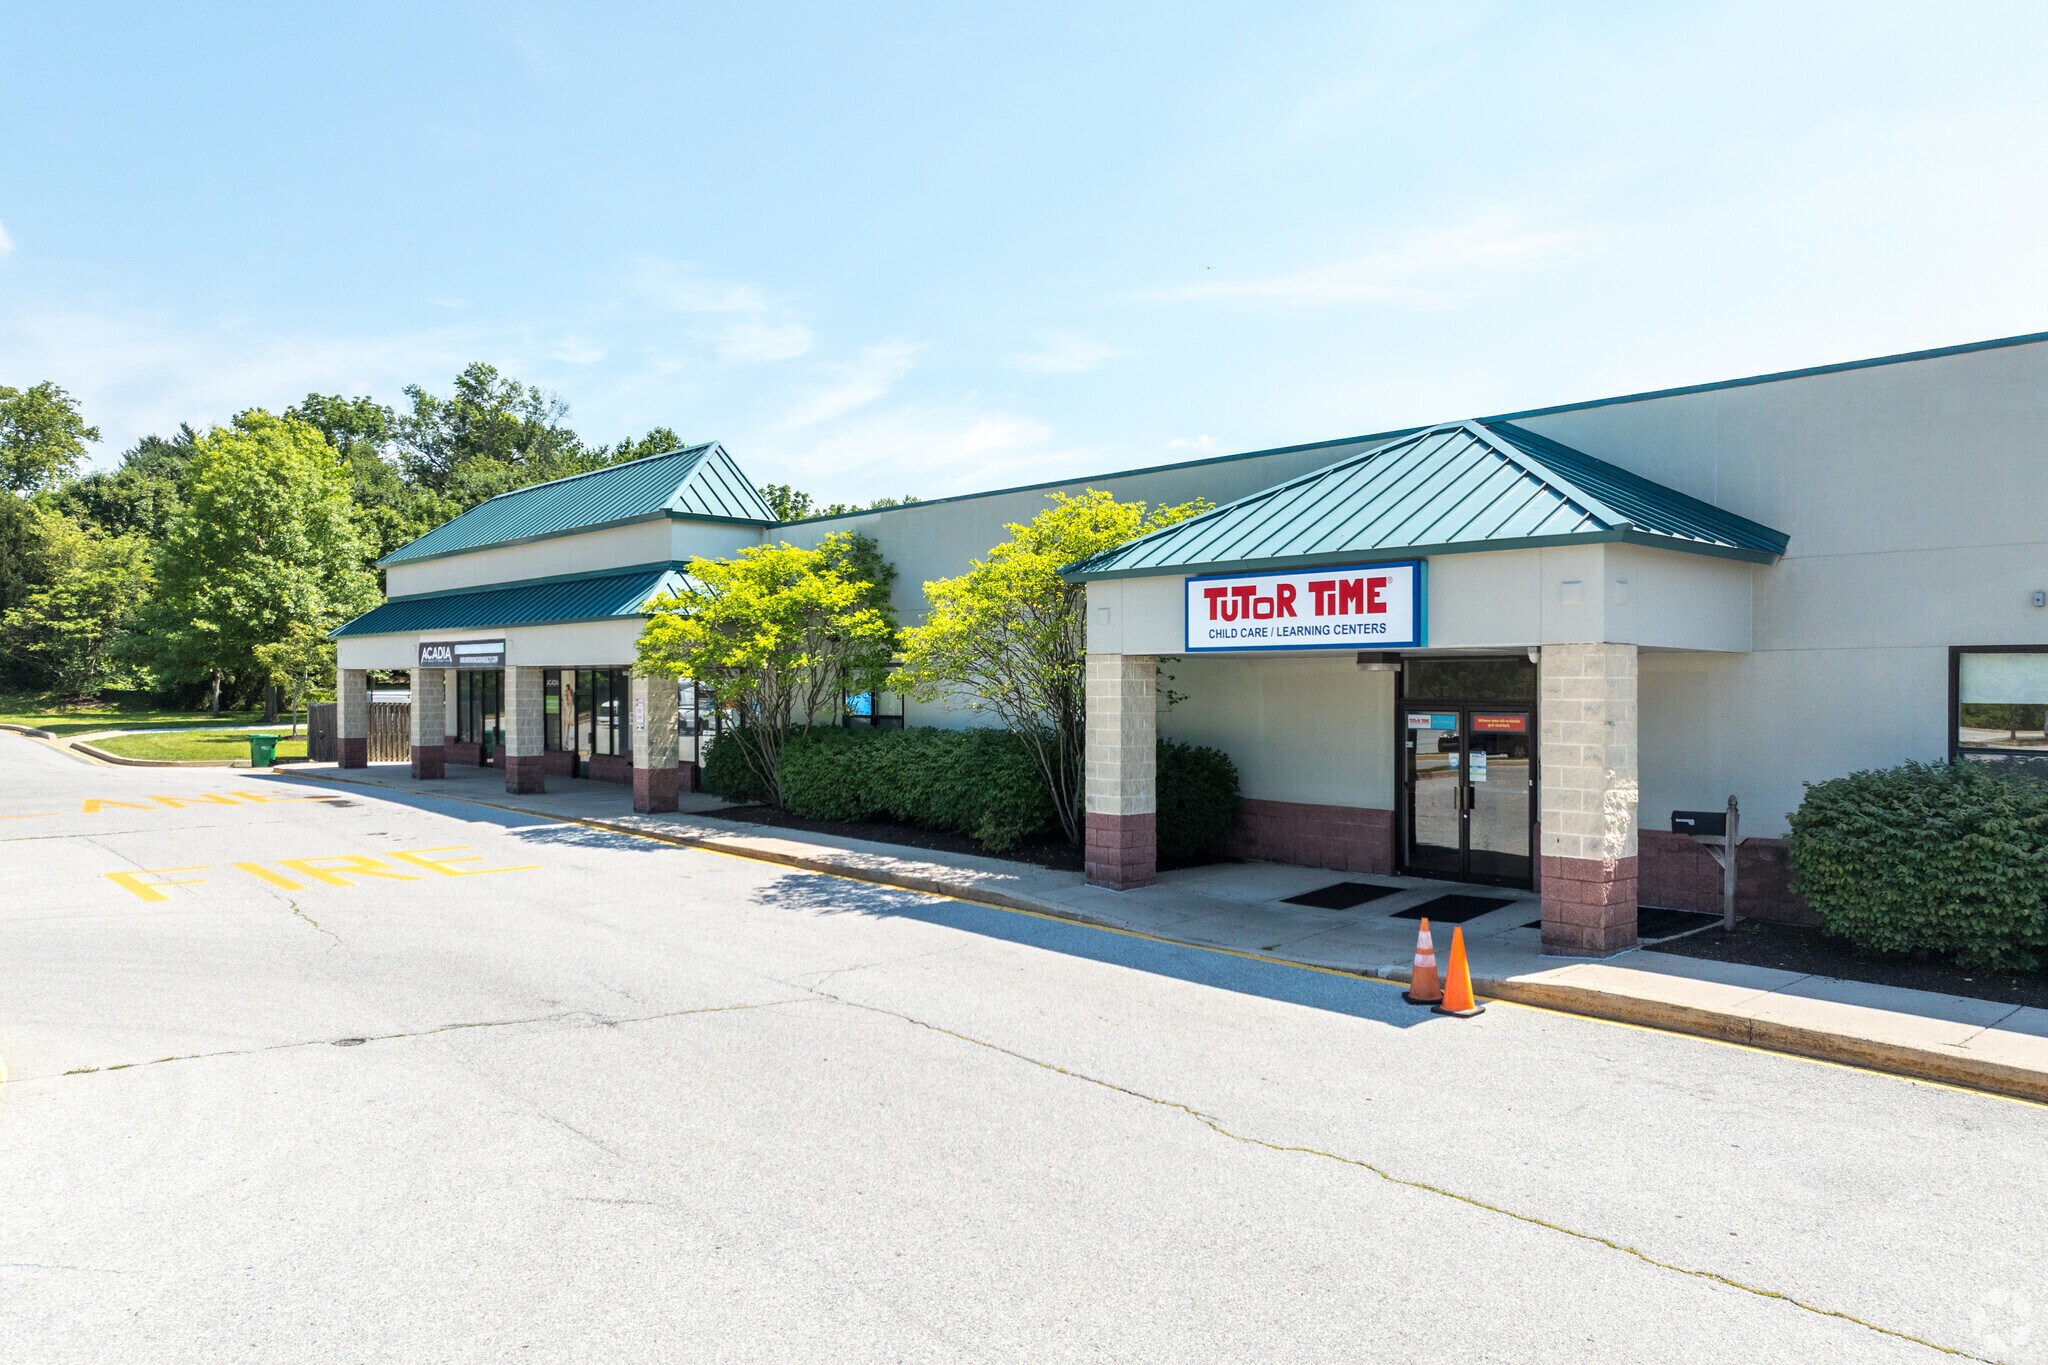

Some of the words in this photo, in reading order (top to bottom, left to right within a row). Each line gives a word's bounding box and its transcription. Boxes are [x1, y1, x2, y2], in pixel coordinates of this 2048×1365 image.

[1203, 583, 1297, 621] TUTOR
[1208, 628, 1238, 640] CHILD
[1240, 627, 1268, 639] CARE
[1276, 625, 1330, 638] LEARNING
[1333, 622, 1387, 636] CENTERS
[421, 646, 452, 663] ACADIA
[105, 845, 541, 902] FIRE
